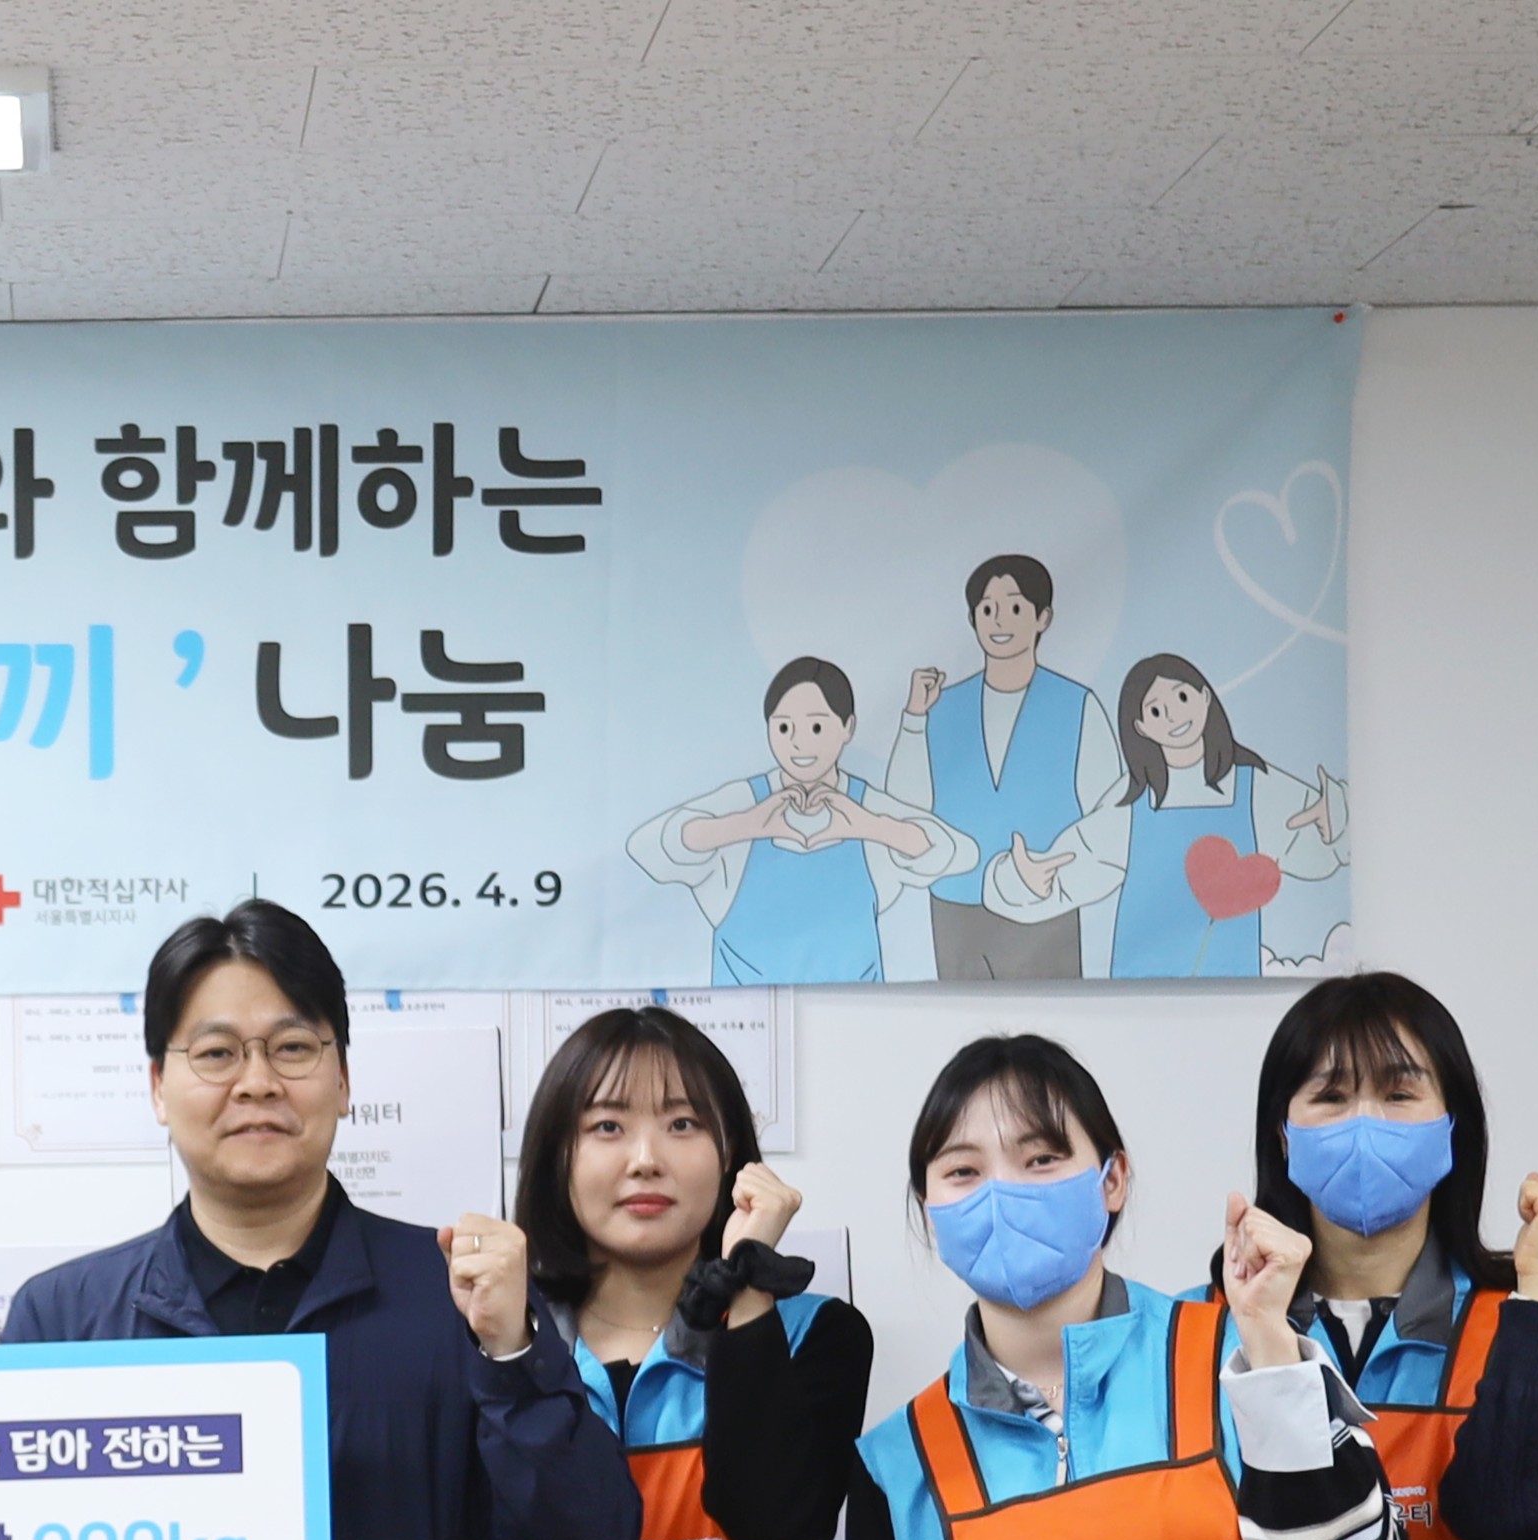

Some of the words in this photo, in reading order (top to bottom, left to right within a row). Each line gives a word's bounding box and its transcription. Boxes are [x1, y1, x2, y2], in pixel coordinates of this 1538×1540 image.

[92, 421, 604, 561] 함께하는
[255, 622, 546, 781] 나눔
[32, 876, 191, 905] 대한적십자사
[9, 1427, 91, 1472] 담아
[101, 1424, 225, 1469] 전하는
